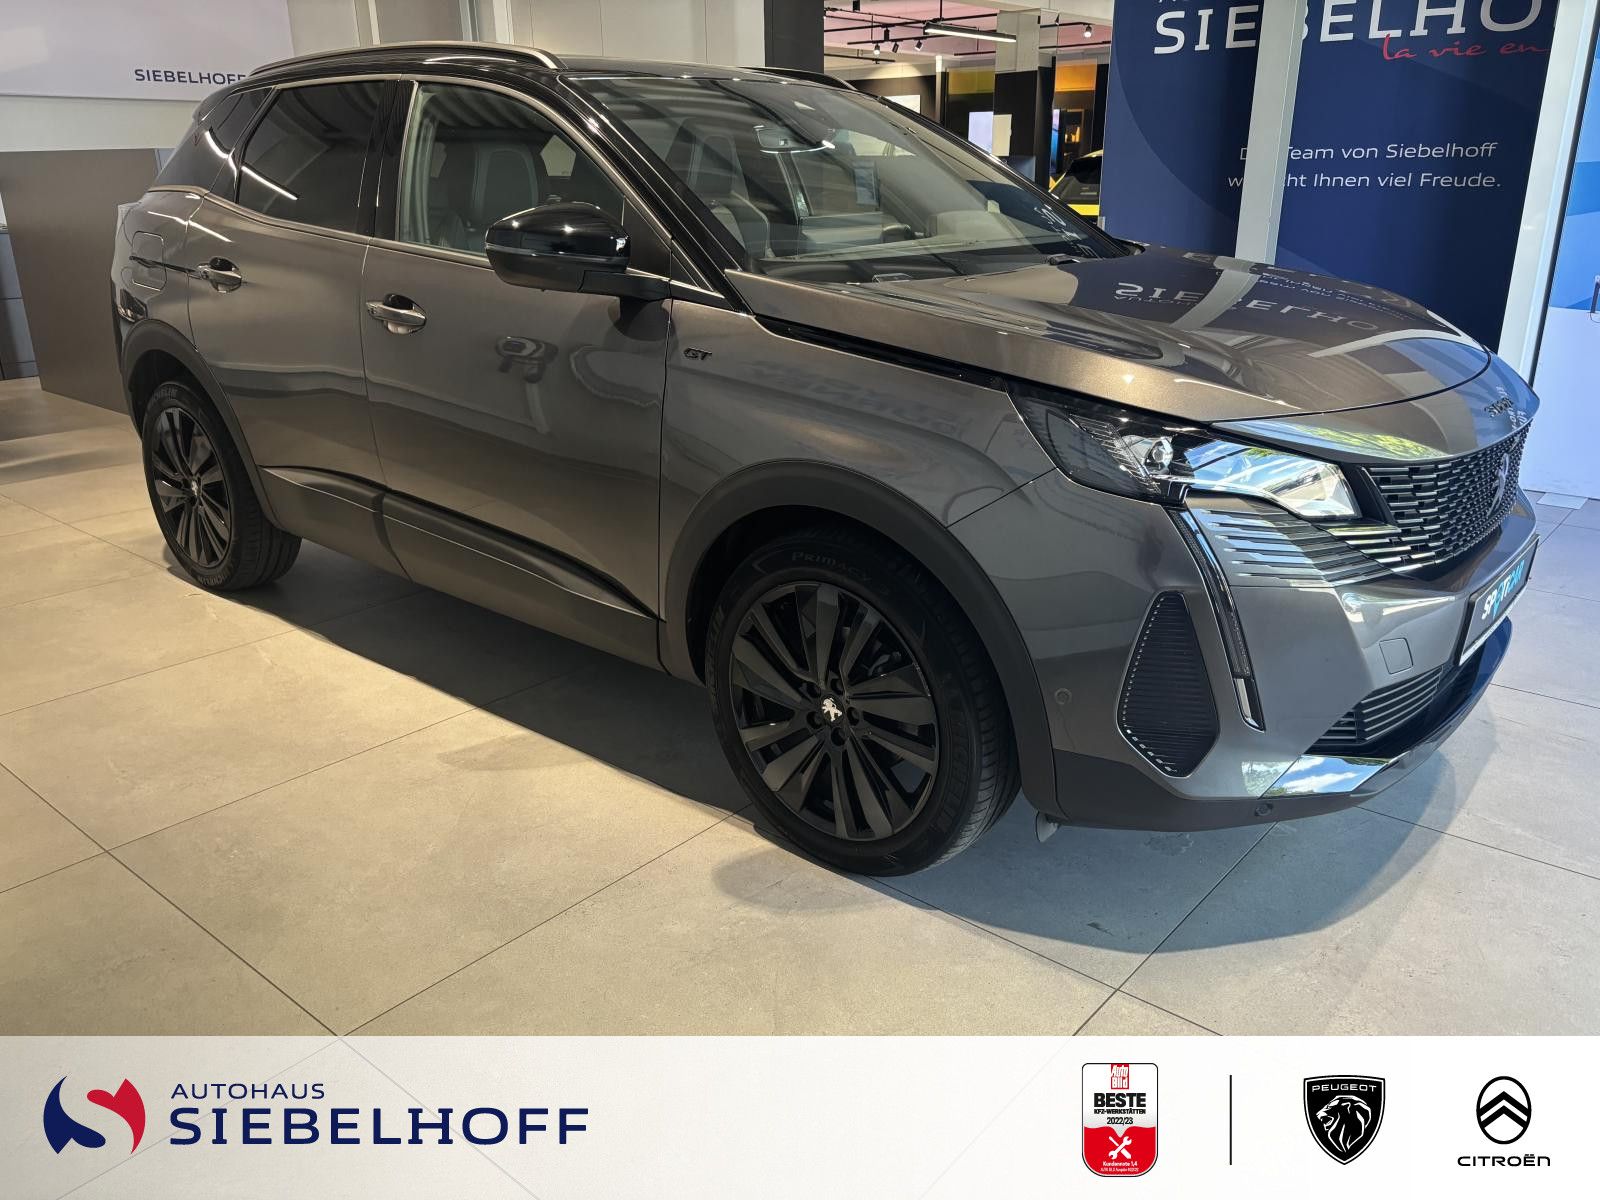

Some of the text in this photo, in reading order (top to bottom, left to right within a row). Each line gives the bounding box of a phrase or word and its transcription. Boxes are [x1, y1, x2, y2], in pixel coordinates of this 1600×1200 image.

[1382, 34, 1416, 60] la
[1429, 40, 1486, 58] vie
[1341, 147, 1378, 159] von
[1385, 142, 1498, 158] Siebelhoff
[1313, 173, 1370, 187] Ihnen
[1377, 172, 1412, 187] viel
[1420, 172, 1501, 187] Freude.
[684, 347, 712, 361] GT
